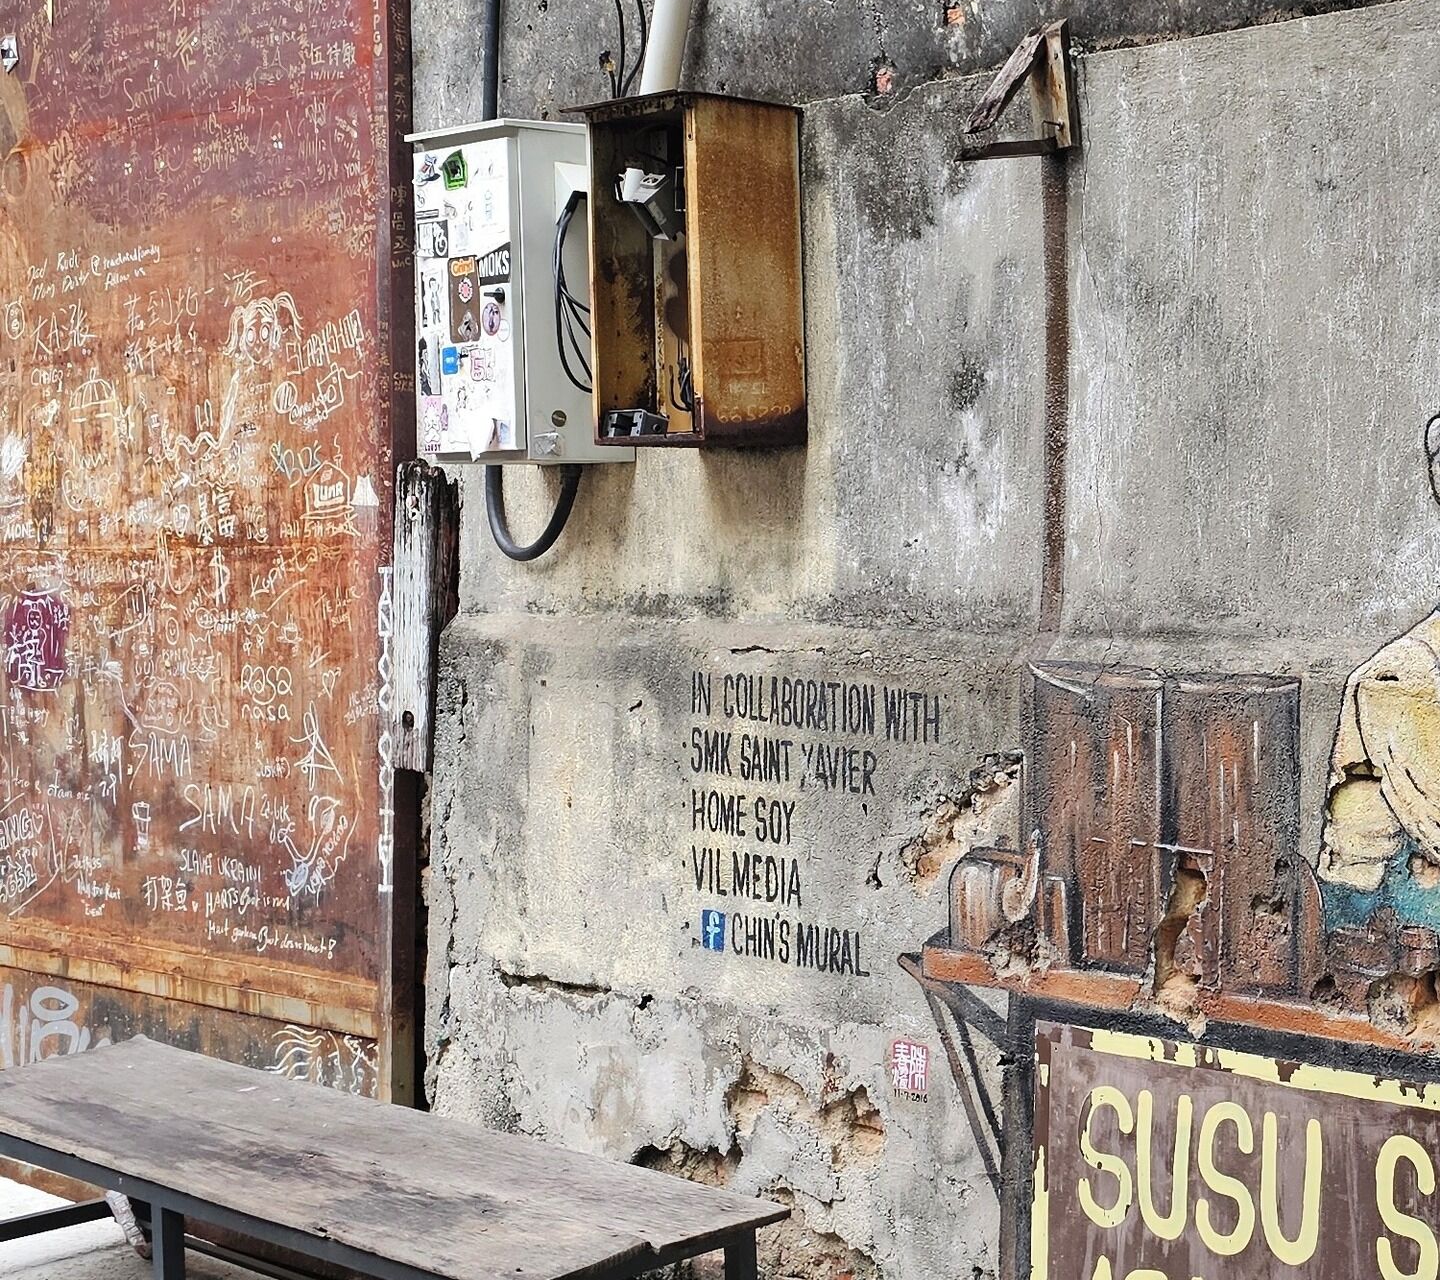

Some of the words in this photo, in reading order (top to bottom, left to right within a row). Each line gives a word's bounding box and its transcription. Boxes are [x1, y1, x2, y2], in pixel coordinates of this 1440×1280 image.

[479, 249, 511, 278] MOKS
[691, 672, 711, 717] IN
[723, 673, 876, 736] COLLABORATION
[883, 686, 940, 744] WITH
[690, 727, 732, 777] SMK
[740, 734, 794, 784] SAINT
[800, 743, 878, 796] XAVIER
[691, 789, 747, 837] HOME
[754, 796, 796, 845] SOY
[730, 911, 790, 965] CHIN'S
[796, 922, 871, 977] MURAL
[1077, 1085, 1323, 1266] SUSU
